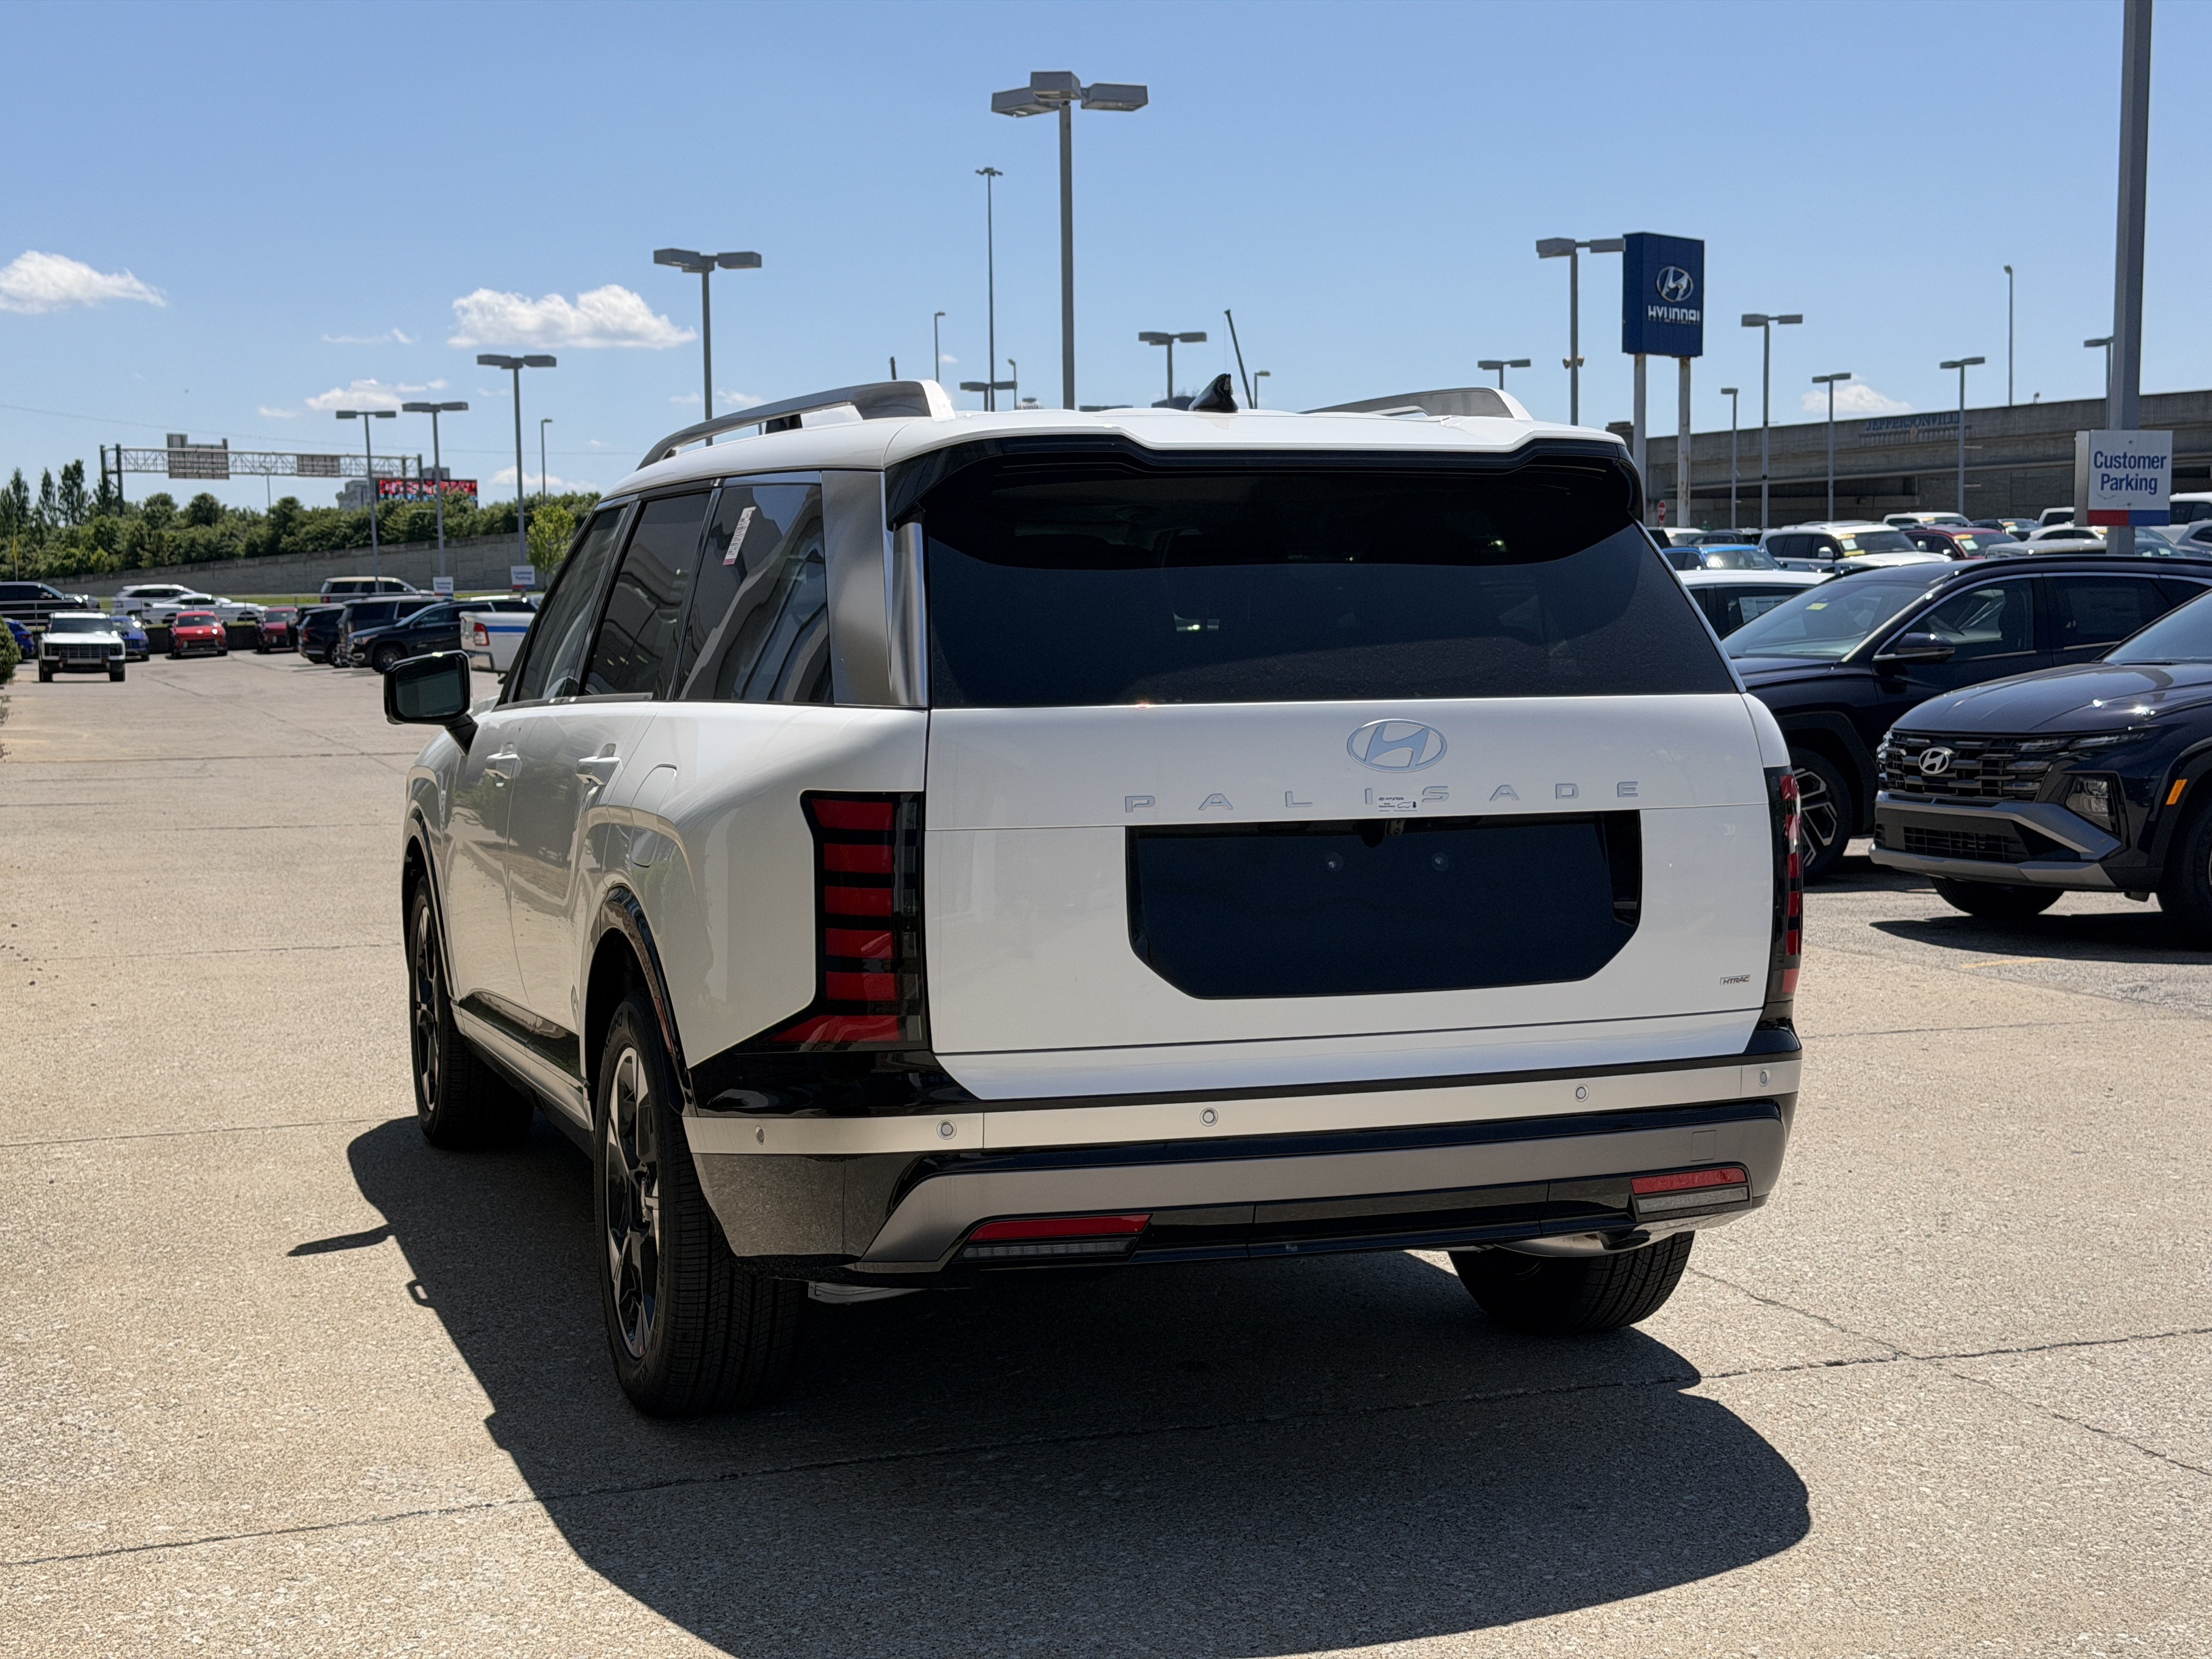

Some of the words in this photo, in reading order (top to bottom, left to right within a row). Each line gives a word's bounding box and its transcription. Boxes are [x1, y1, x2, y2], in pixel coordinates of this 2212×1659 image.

[1648, 305, 1700, 321] HYUNDAI
[2094, 451, 2166, 469] Customer
[2100, 473, 2158, 495] Parking
[1125, 782, 1639, 813] PALISADE
[1723, 976, 1749, 986] HTRAC
